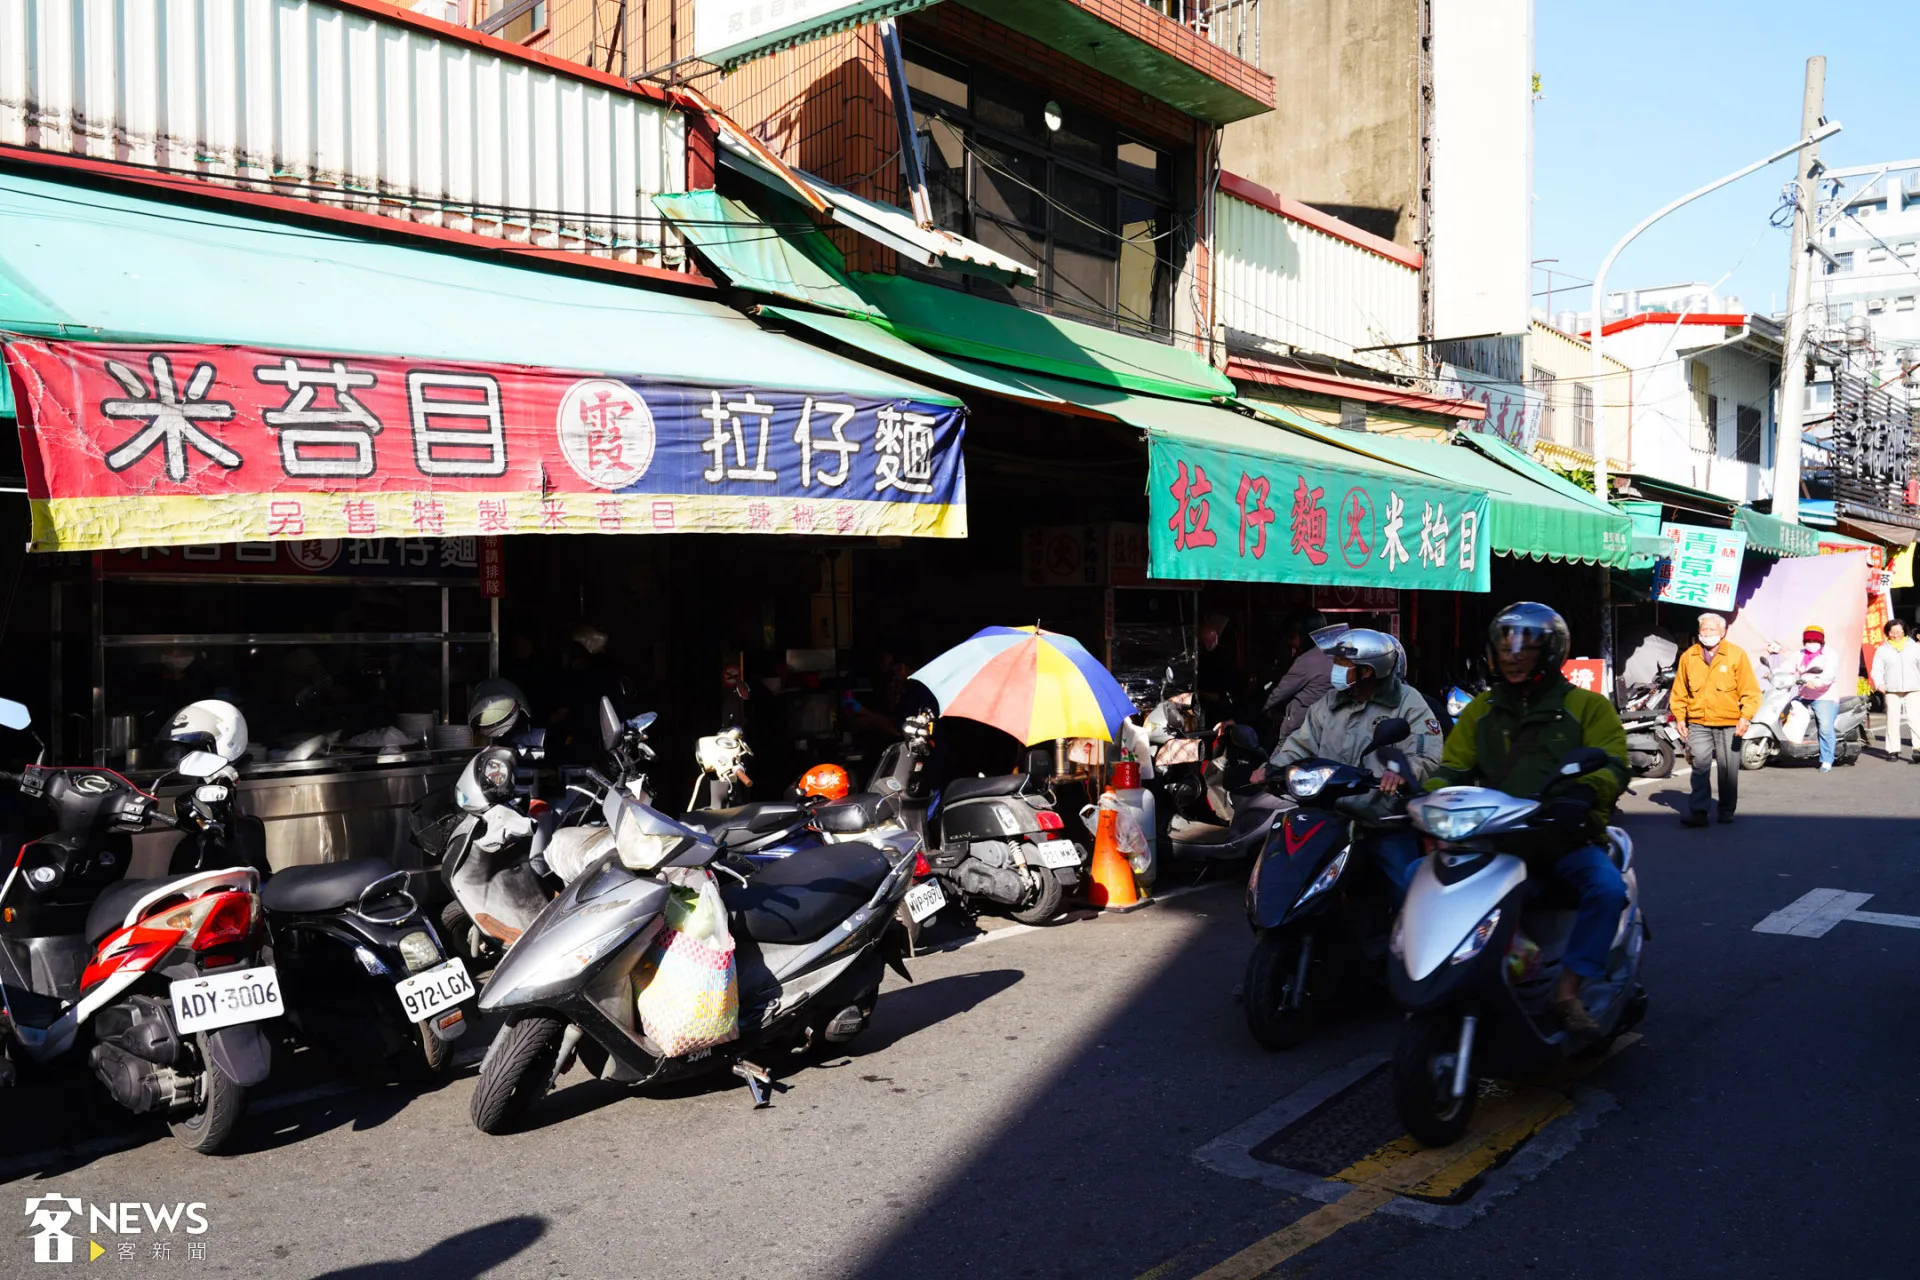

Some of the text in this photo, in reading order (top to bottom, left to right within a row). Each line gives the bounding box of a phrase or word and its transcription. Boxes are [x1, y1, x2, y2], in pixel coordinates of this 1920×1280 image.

[100, 353, 507, 482] 米苔目
[701, 389, 937, 494] 拉仔麵
[268, 499, 676, 537] 另售特製米苔目
[1168, 459, 1329, 566] 拉仔麵
[1343, 494, 1370, 555] 火
[1675, 531, 1718, 603] 青草茶
[181, 981, 278, 1020] ADY-3006
[404, 970, 472, 1015] 972-LGX
